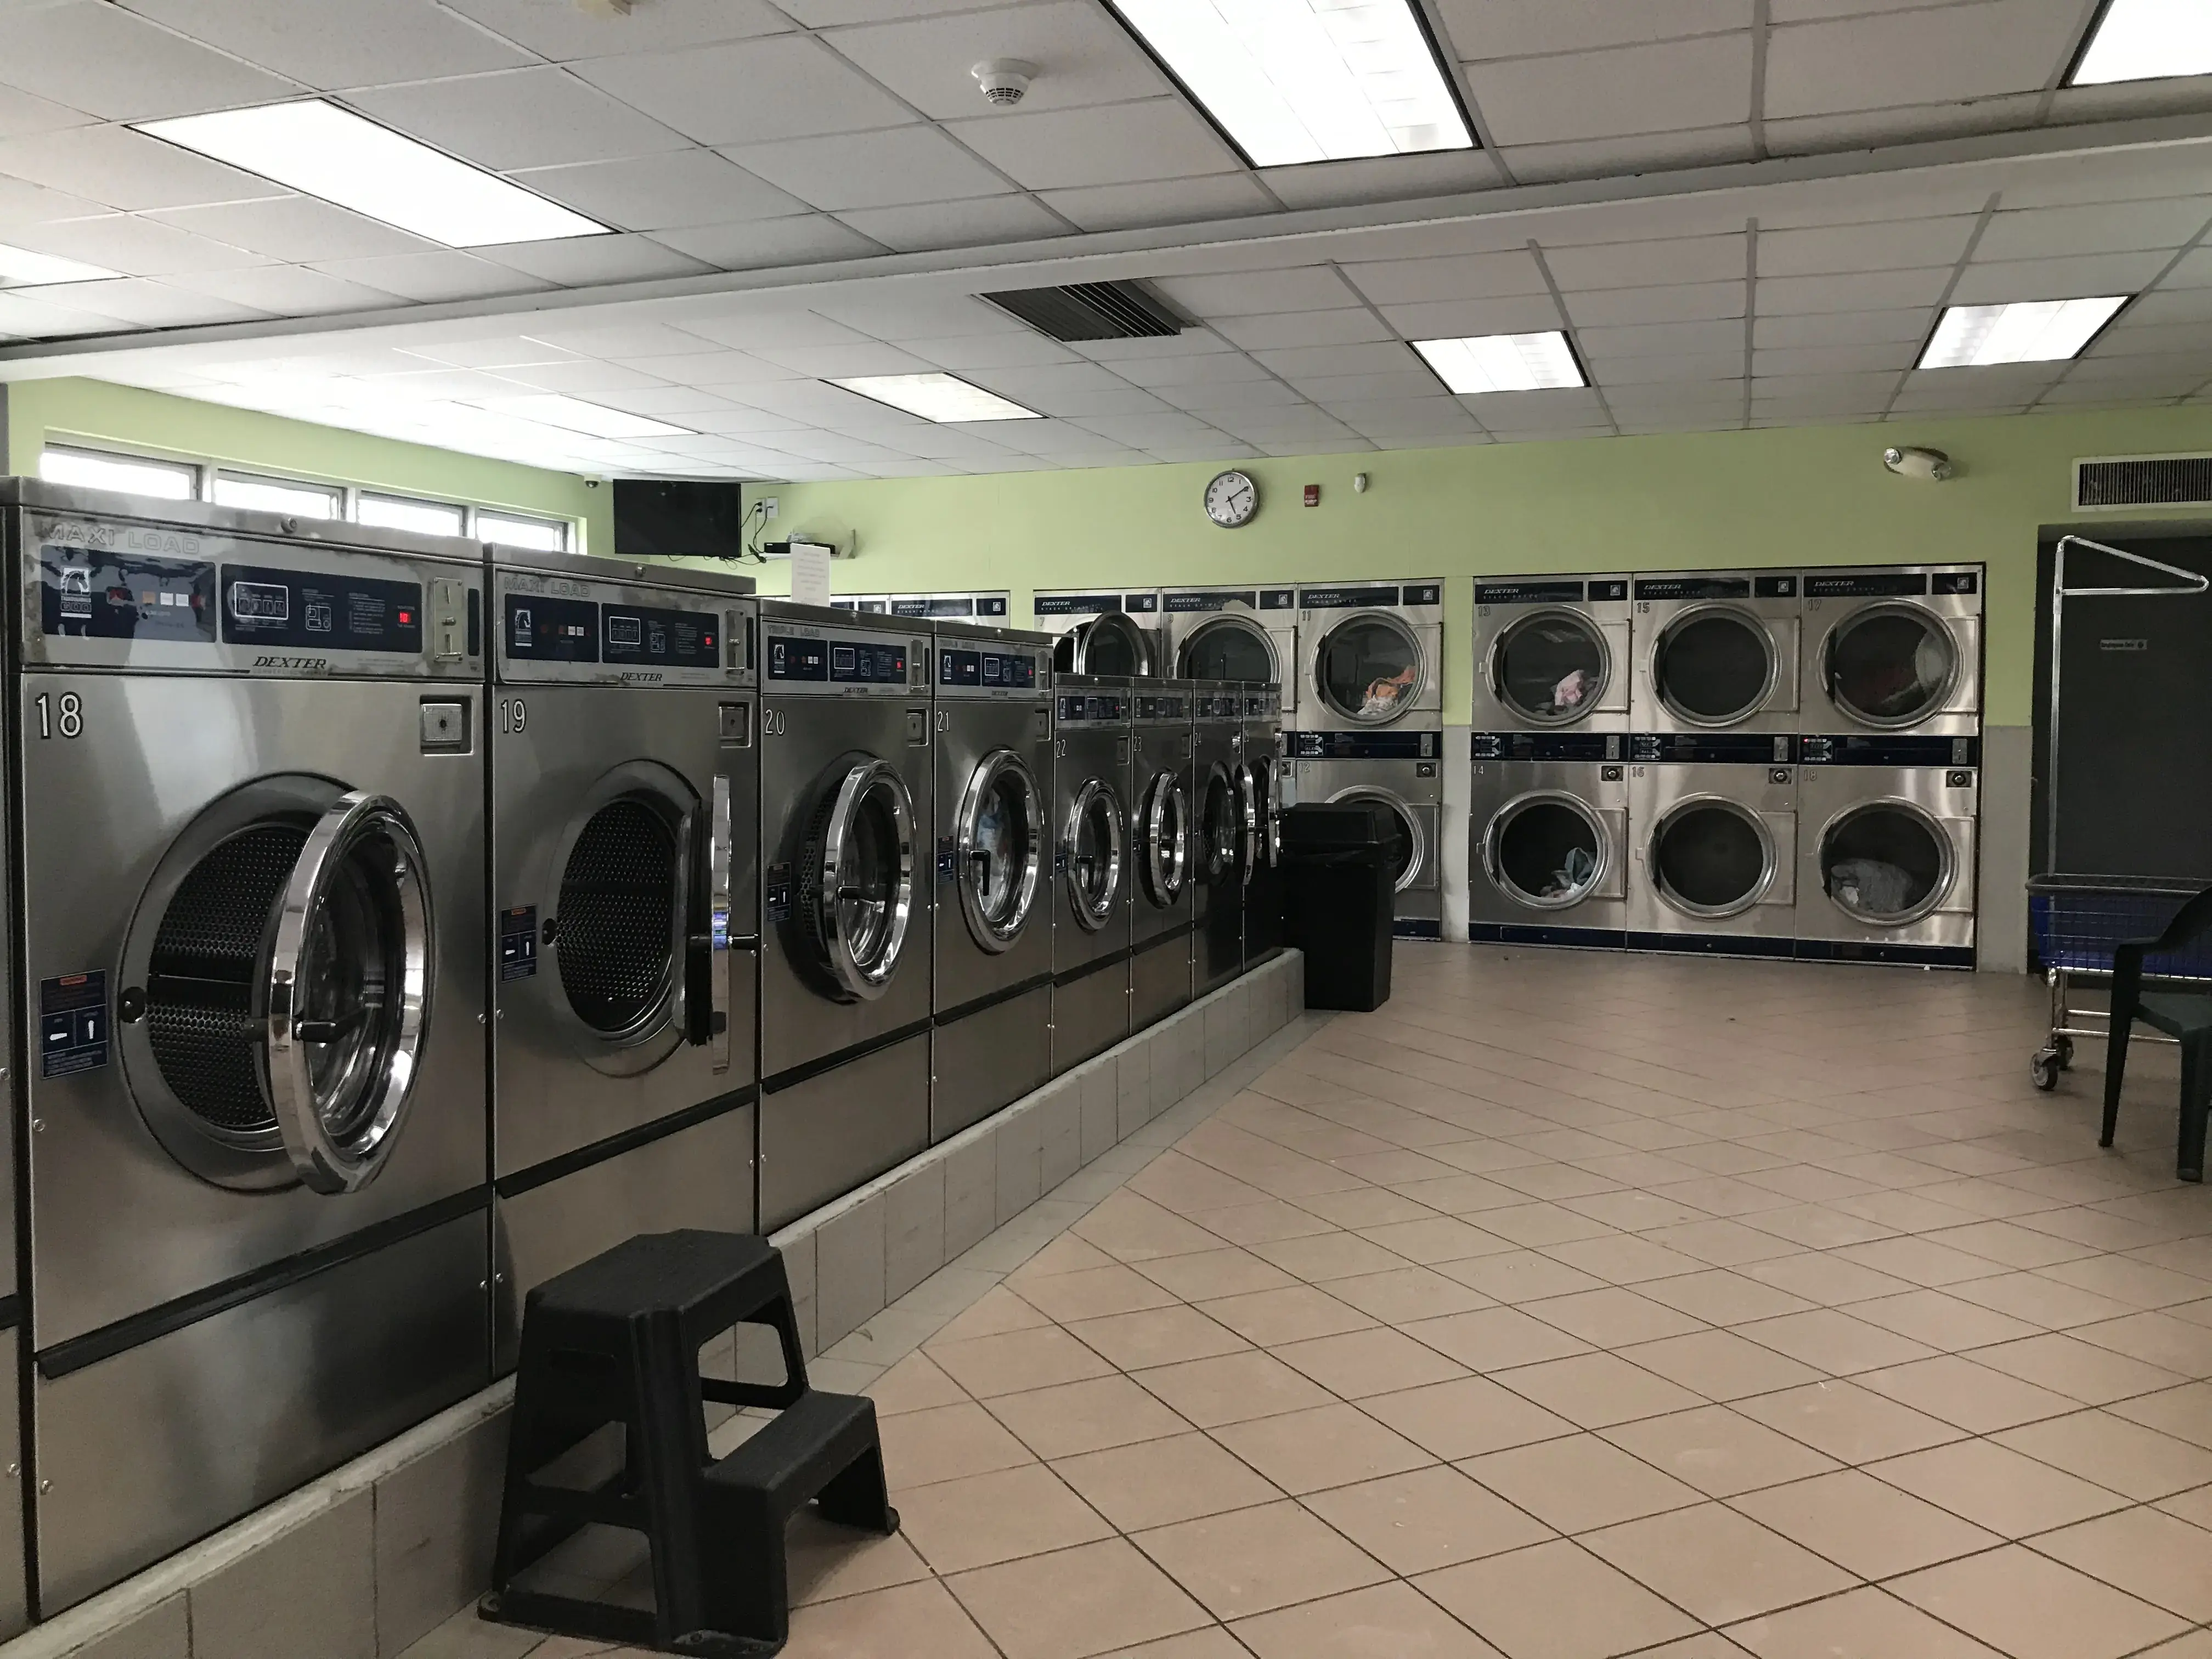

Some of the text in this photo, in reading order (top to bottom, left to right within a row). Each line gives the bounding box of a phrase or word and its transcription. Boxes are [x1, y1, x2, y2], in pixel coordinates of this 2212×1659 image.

[128, 531, 200, 555] LOAD
[504, 577, 590, 597] MAXI LOAD
[1477, 605, 1491, 617] 13
[1637, 602, 1650, 613] 15
[1808, 599, 1822, 611] 17
[1039, 617, 1045, 627] 7
[1167, 613, 1174, 623] 9
[1302, 611, 1311, 621] 11
[252, 656, 327, 669] DEXTER
[620, 672, 663, 682] DEXTER
[35, 691, 83, 739] 18
[500, 698, 527, 734] 19
[765, 709, 786, 736] 20
[938, 711, 950, 732] 21
[1056, 739, 1066, 758] 22
[1134, 736, 1142, 751] 23
[1299, 762, 1310, 772] 12
[1473, 765, 1484, 775] 14
[1632, 766, 1645, 778] 16
[1803, 770, 1817, 781] 18
